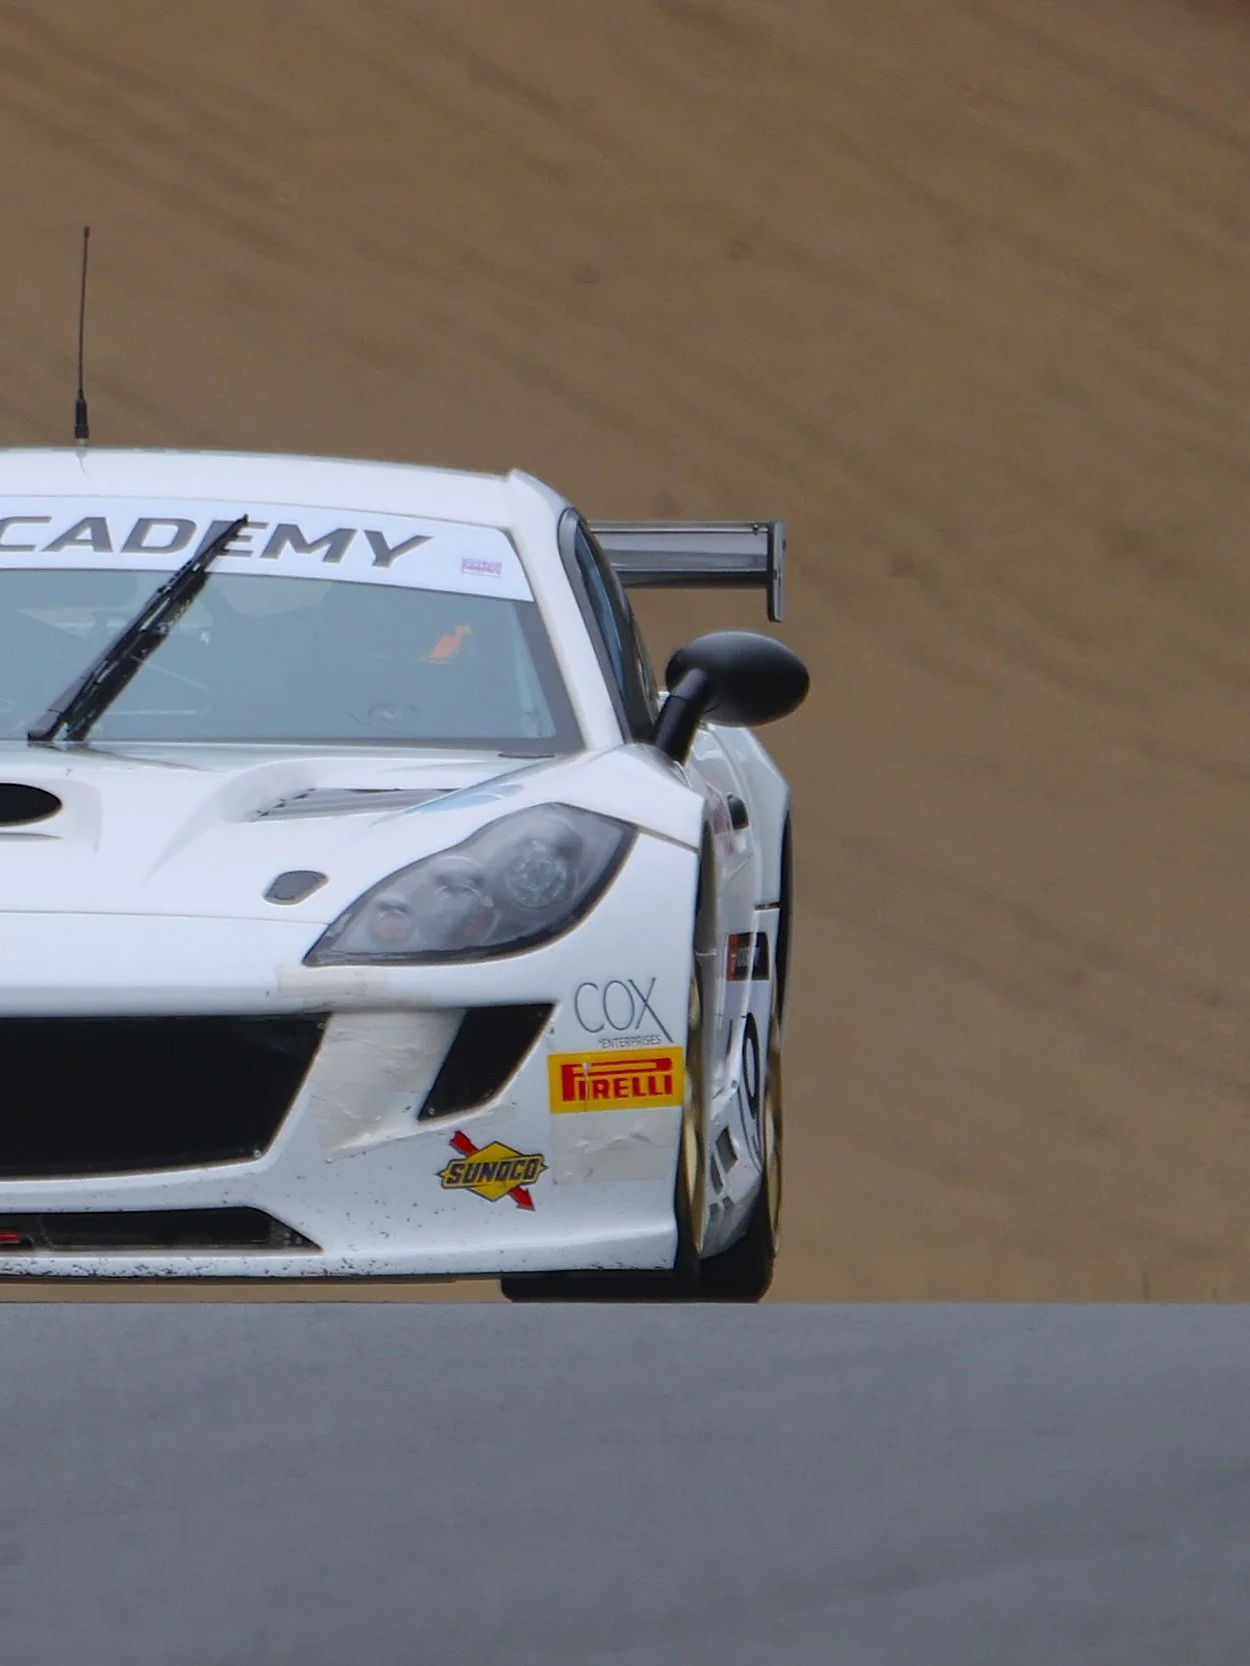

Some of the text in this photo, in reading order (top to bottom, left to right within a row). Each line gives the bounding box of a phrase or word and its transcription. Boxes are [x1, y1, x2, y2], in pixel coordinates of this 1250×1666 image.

[574, 977, 673, 1043] COX
[600, 1034, 662, 1048] ENTERPRISES
[560, 1057, 673, 1103] PIRELLI
[447, 1160, 541, 1184] SUNOCO
